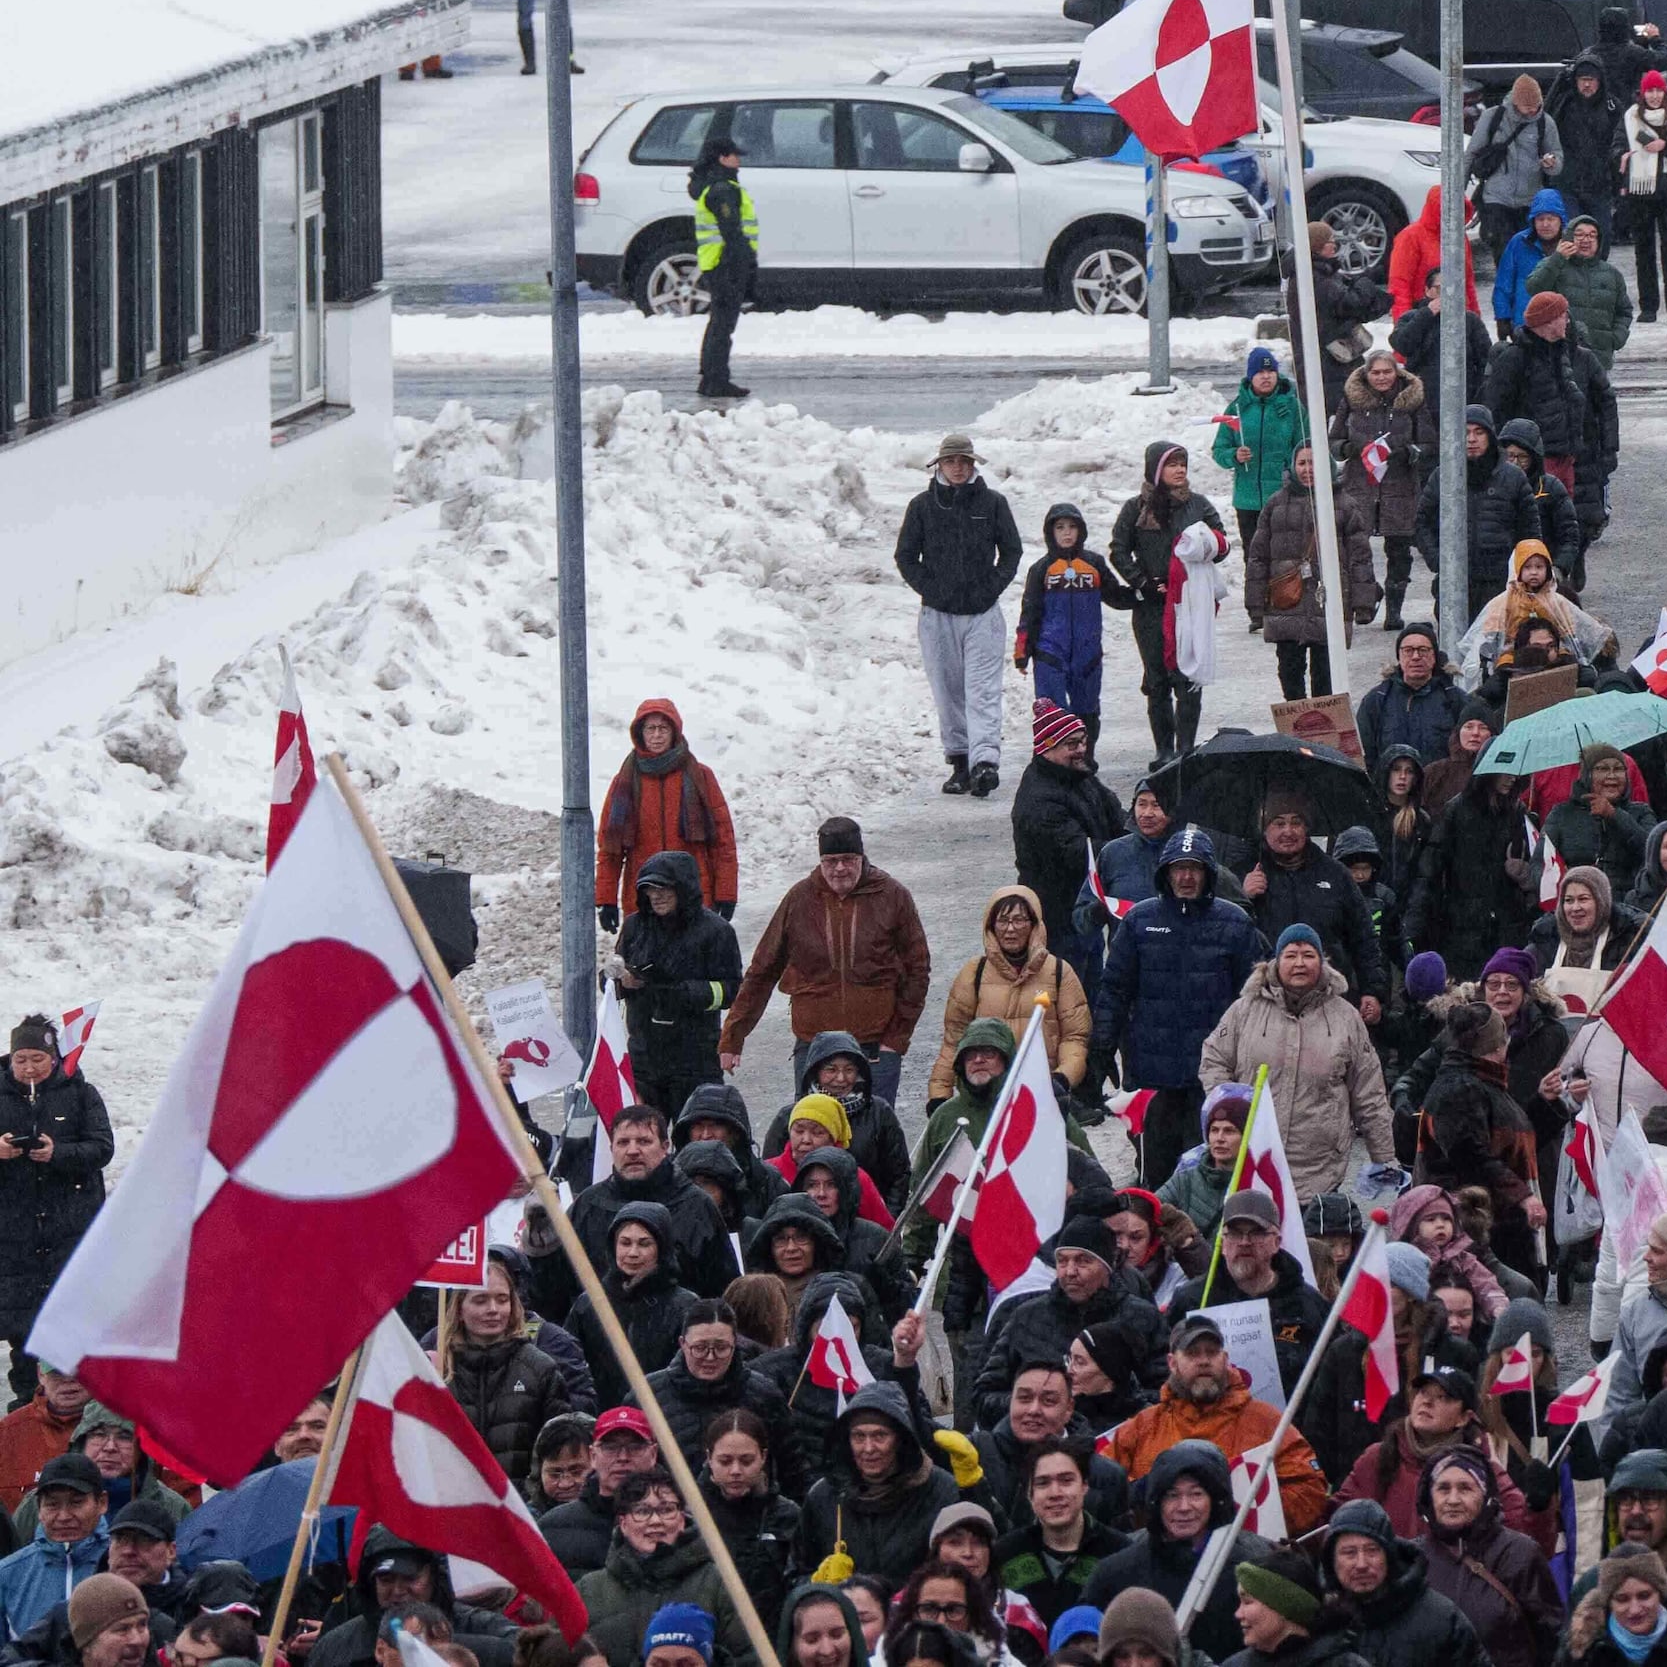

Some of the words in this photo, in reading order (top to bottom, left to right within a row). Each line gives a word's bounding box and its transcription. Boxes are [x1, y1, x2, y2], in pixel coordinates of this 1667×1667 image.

[1048, 572, 1095, 590] FXR
[1230, 1313, 1263, 1328] nunaat
[1230, 1330, 1262, 1345] pigaat
[650, 1632, 688, 1645] CRAFT
